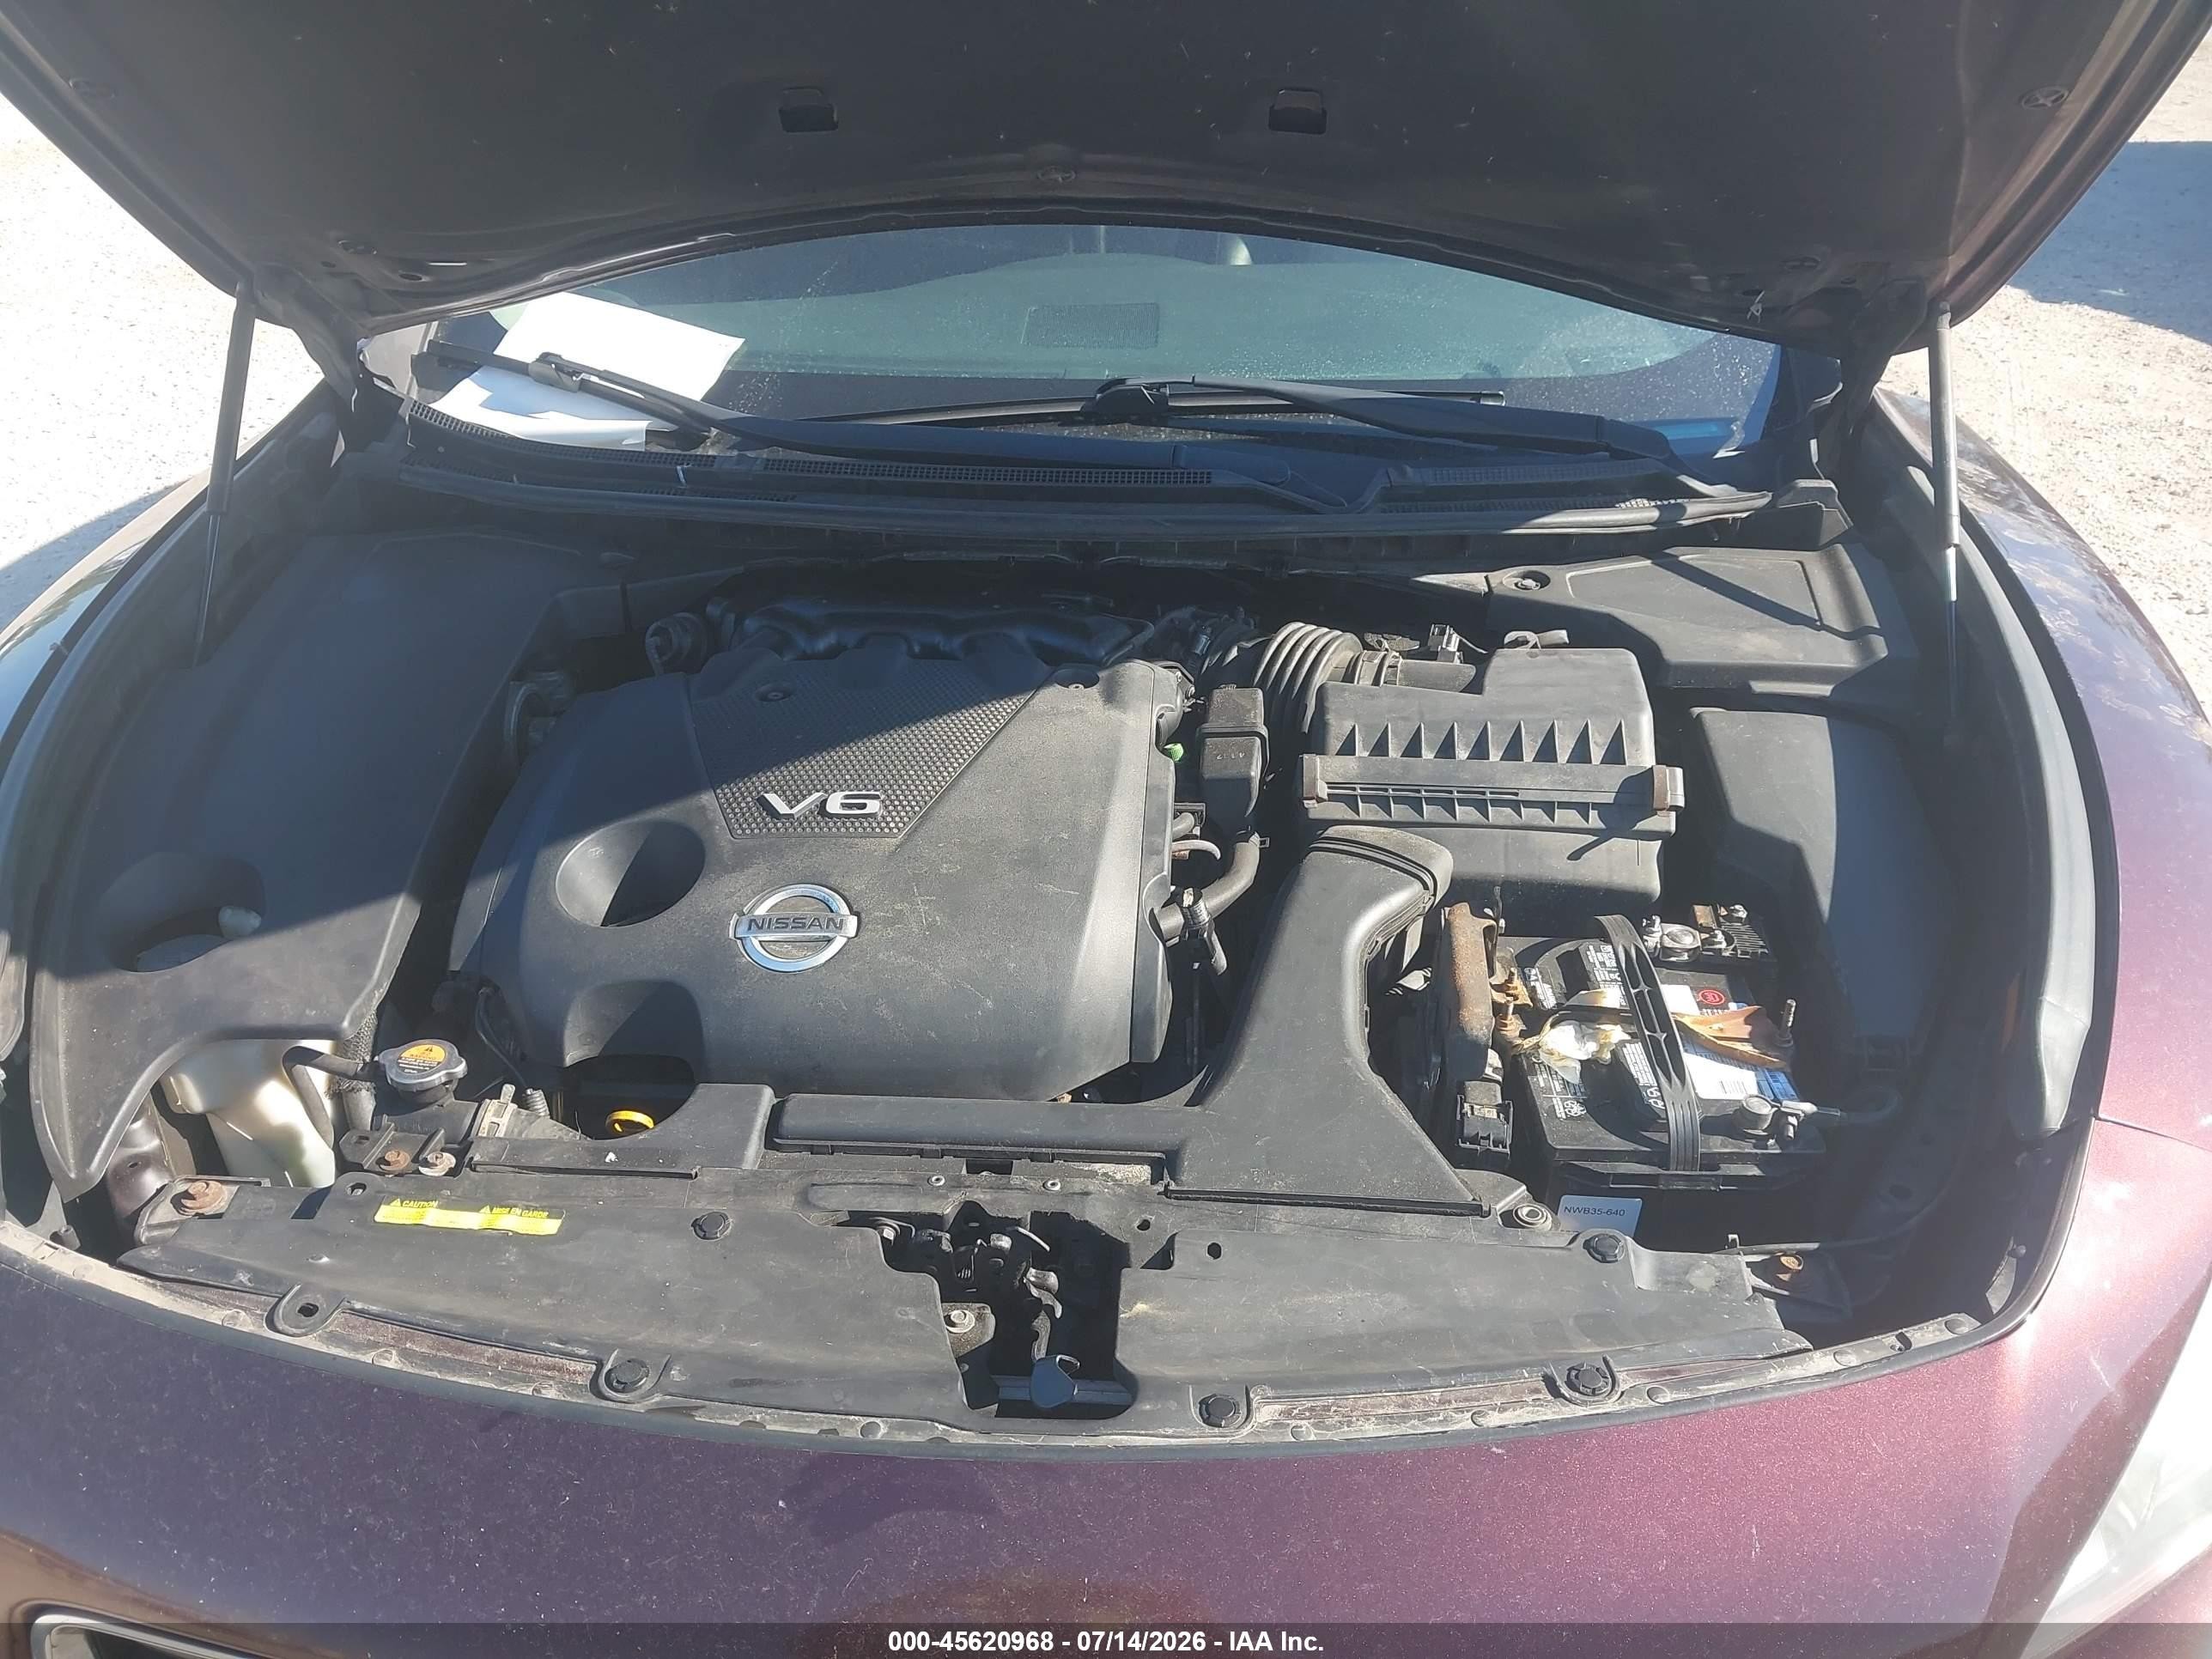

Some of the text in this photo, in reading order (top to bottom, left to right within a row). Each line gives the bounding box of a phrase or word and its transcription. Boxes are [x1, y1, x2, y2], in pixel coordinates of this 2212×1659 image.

[757, 791, 883, 819] V6
[747, 917, 845, 932] NISSAN
[402, 1200, 439, 1208] CAUTION
[510, 1207, 522, 1216] EN
[522, 1210, 549, 1218] GARDE
[1564, 1206, 1626, 1217] NWB35-640
